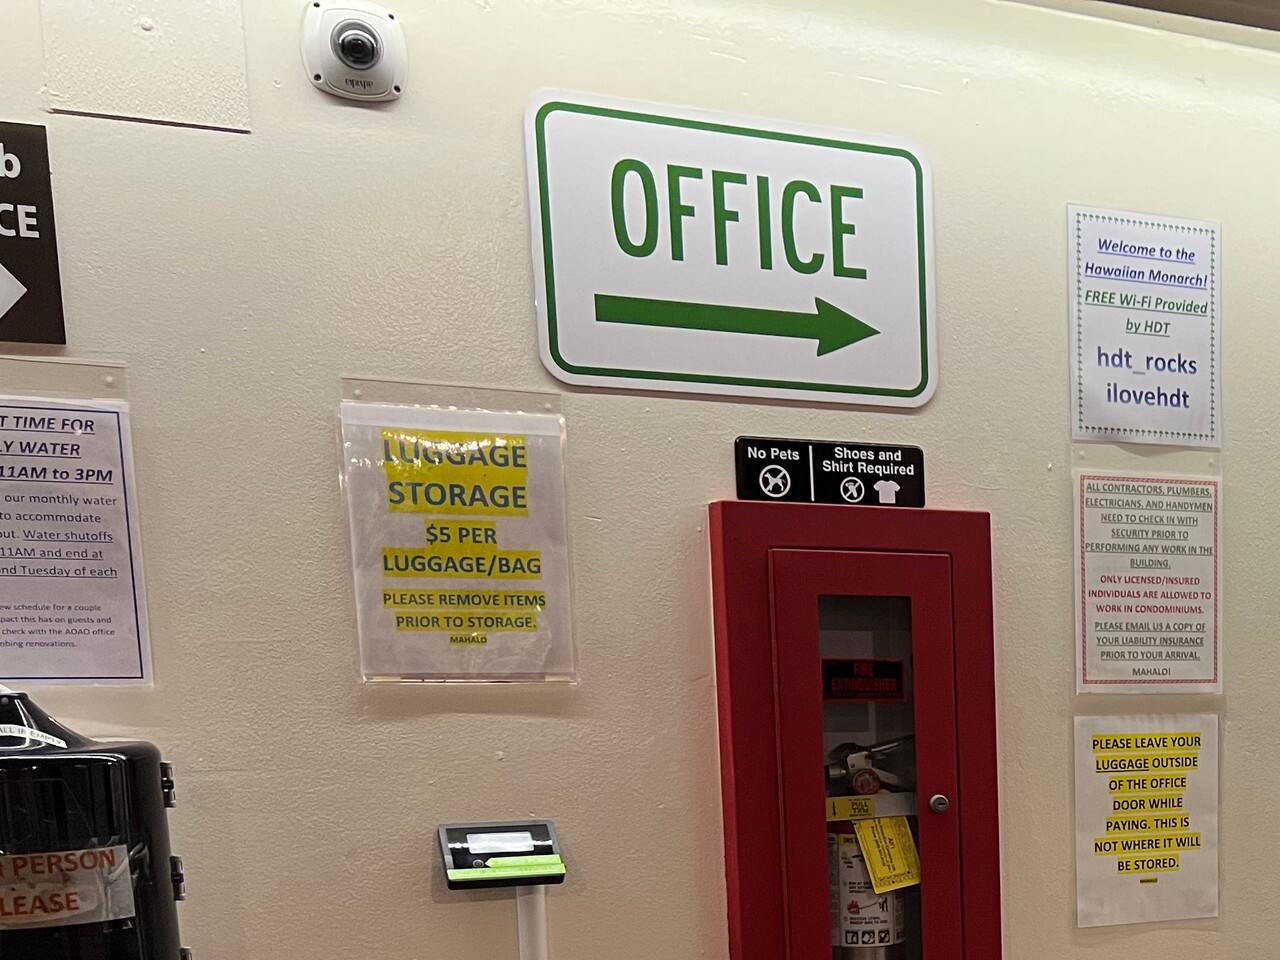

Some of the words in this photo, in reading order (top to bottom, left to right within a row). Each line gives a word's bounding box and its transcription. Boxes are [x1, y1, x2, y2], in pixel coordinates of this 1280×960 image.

[611, 158, 867, 280] OFFICE
[1098, 238, 1156, 257] Welcome
[1160, 246, 1172, 259] to
[1176, 248, 1195, 262] the
[1085, 262, 1144, 280] Hawaiian
[1149, 269, 1207, 287] Monarch!
[1085, 290, 1116, 304] FREE
[1120, 293, 1151, 308] Wi-Fi
[1155, 297, 1208, 314] Provided
[1126, 318, 1140, 334] by
[1144, 321, 1171, 334] HDT
[1097, 346, 1197, 374] hdt_rocks
[1107, 383, 1189, 408] ilovehdt
[13, 416, 56, 429] TIME
[62, 419, 94, 431] FOR
[20, 442, 80, 455] WATER
[383, 439, 527, 468] LUGGAGE
[748, 447, 766, 459] No
[771, 448, 800, 460] Pets
[835, 447, 874, 460] Shoes
[878, 450, 901, 461] and
[0, 466, 46, 479] 11AM
[53, 469, 69, 479] to
[75, 469, 113, 481] 3PM
[823, 461, 853, 472] Shirt
[858, 462, 914, 476] Required
[389, 482, 527, 509] STORAGE
[1087, 483, 1099, 492] ALL
[1103, 483, 1165, 495] CONTRACTORS,
[30, 495, 79, 506] monthly
[83, 497, 117, 506] water
[16, 513, 101, 523] accommodate
[23, 530, 60, 539] Water
[65, 530, 113, 541] shutoffs
[426, 524, 450, 544] $5
[459, 527, 497, 544] PER
[1112, 529, 1149, 538] SECURITY
[1152, 530, 1175, 538] PRIOR
[1178, 531, 1189, 539] TO
[1, 548, 35, 556] 11AM
[40, 548, 61, 557] and
[66, 549, 88, 557] end
[92, 550, 103, 558] at
[20, 566, 70, 577] Tuesday
[74, 567, 86, 575] of
[90, 568, 117, 576] each
[383, 555, 541, 576] LUGGAGE/BAG
[1101, 576, 1122, 584] ONLY
[1125, 576, 1200, 586] LICENSED/INSURED
[384, 593, 434, 605] PLEASE
[439, 594, 500, 606] REMOVE
[504, 595, 545, 607] ITEMS
[1089, 590, 1141, 598] INDIVIDUALS
[1143, 591, 1158, 599] ARE
[1161, 591, 1198, 599] ALLOWED
[1201, 592, 1211, 600] TO
[1096, 604, 1121, 613] WORK
[1124, 605, 1132, 613] IN
[1135, 605, 1204, 614] CONDOMINIUMS.
[397, 616, 440, 628] PRIOR
[444, 616, 464, 627] TO
[468, 616, 536, 628] STORAGE.
[1132, 667, 1171, 676] MAHALO!
[1092, 738, 1131, 749] PLEASE
[1135, 738, 1168, 748] LEAVE
[1171, 736, 1200, 747] YOUR
[1096, 759, 1149, 771] LUGGAGE
[1152, 757, 1198, 768] OUTSIDE
[1109, 780, 1123, 790] OF
[1127, 779, 1147, 789] THE
[1151, 777, 1186, 788] OFFICE
[1113, 800, 1146, 810] DOOR
[1149, 798, 1183, 809] WHILE
[1106, 819, 1150, 831] PAYING.
[1154, 818, 1177, 828] THIS
[1180, 817, 1189, 827] IS
[1095, 842, 1118, 852] NOT
[1122, 839, 1160, 850] WHERE
[1163, 838, 1172, 848] IT
[1176, 837, 1200, 847] WILL
[12, 849, 116, 876] PERSON
[1118, 861, 1130, 871] BE
[1134, 858, 1179, 870] STORED.
